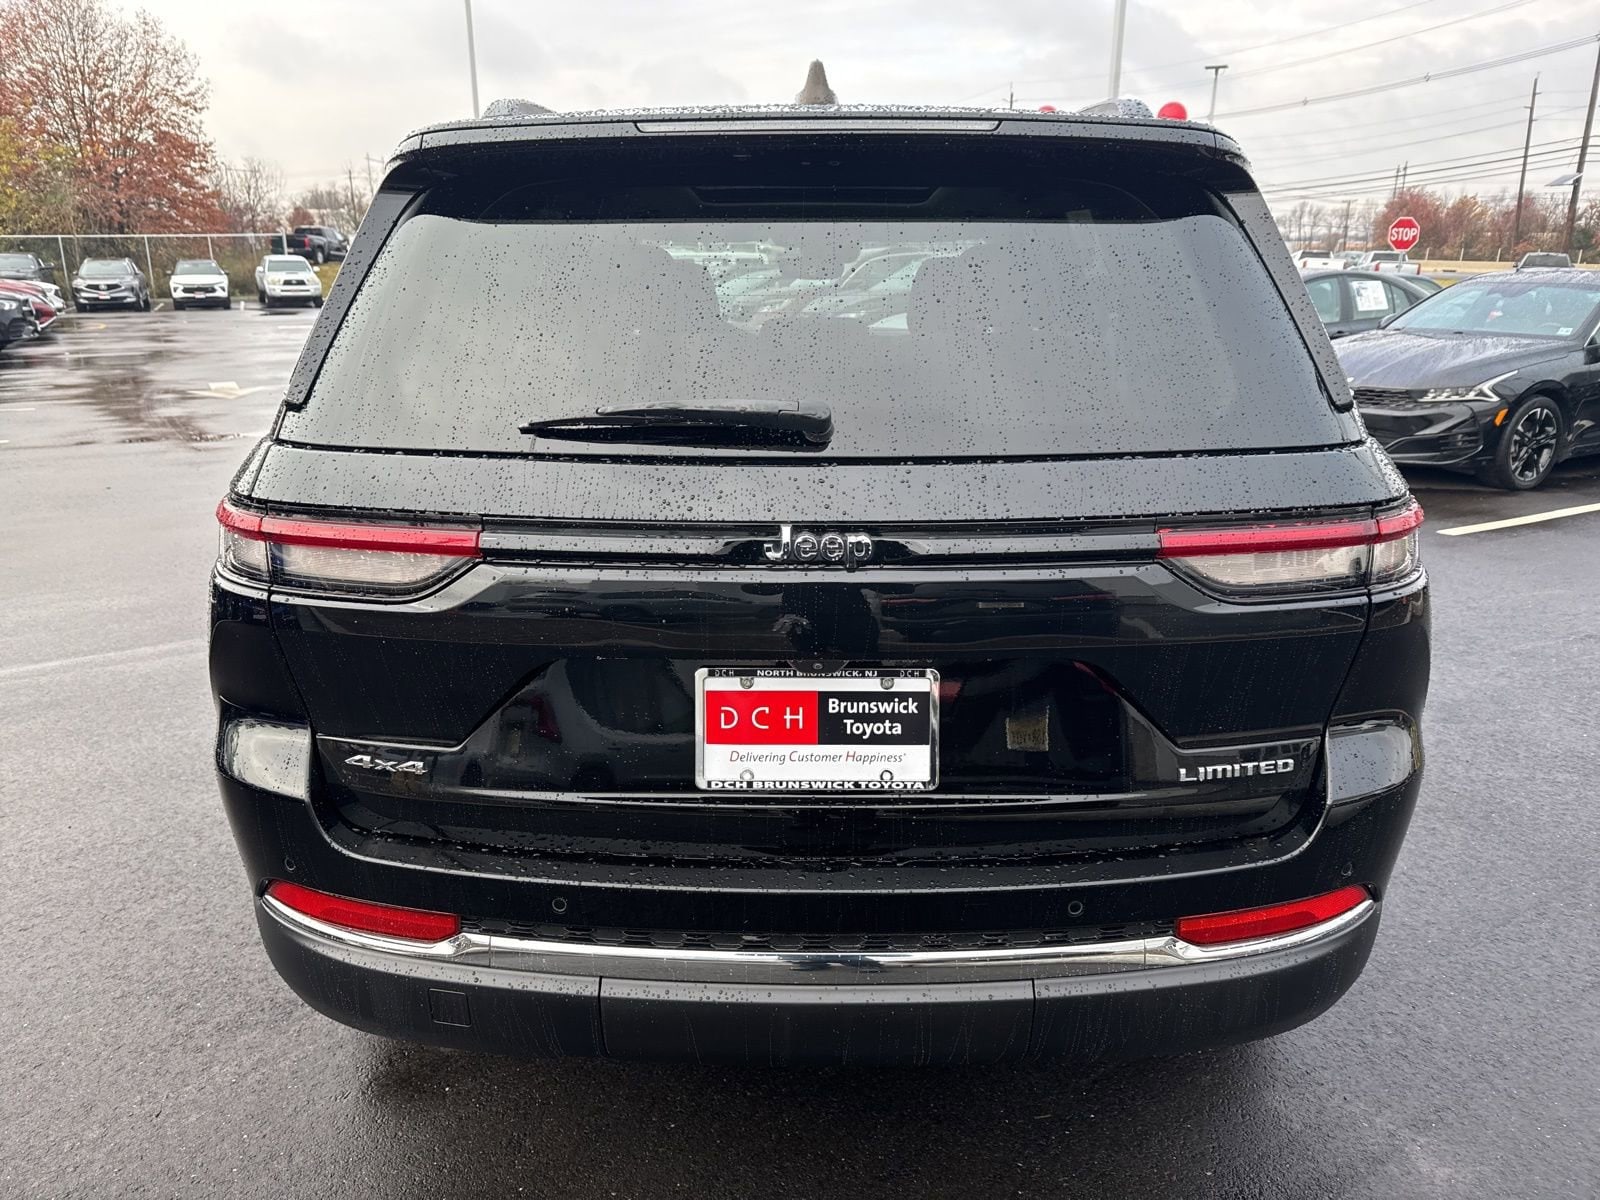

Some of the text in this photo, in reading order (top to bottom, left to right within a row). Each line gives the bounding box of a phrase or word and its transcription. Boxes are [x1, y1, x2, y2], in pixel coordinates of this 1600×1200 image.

[1391, 227, 1418, 241] STOP
[763, 524, 873, 572] Jeep
[756, 669, 794, 677] NORTH
[828, 697, 919, 714] Brunswick
[843, 719, 902, 740] Toyota
[344, 754, 428, 775] 4x4
[729, 750, 786, 766] Delivering
[789, 750, 843, 763] Customer
[1178, 758, 1295, 782] LIMITED
[710, 781, 925, 789] DCH BRUNSWICK TOYOTA
